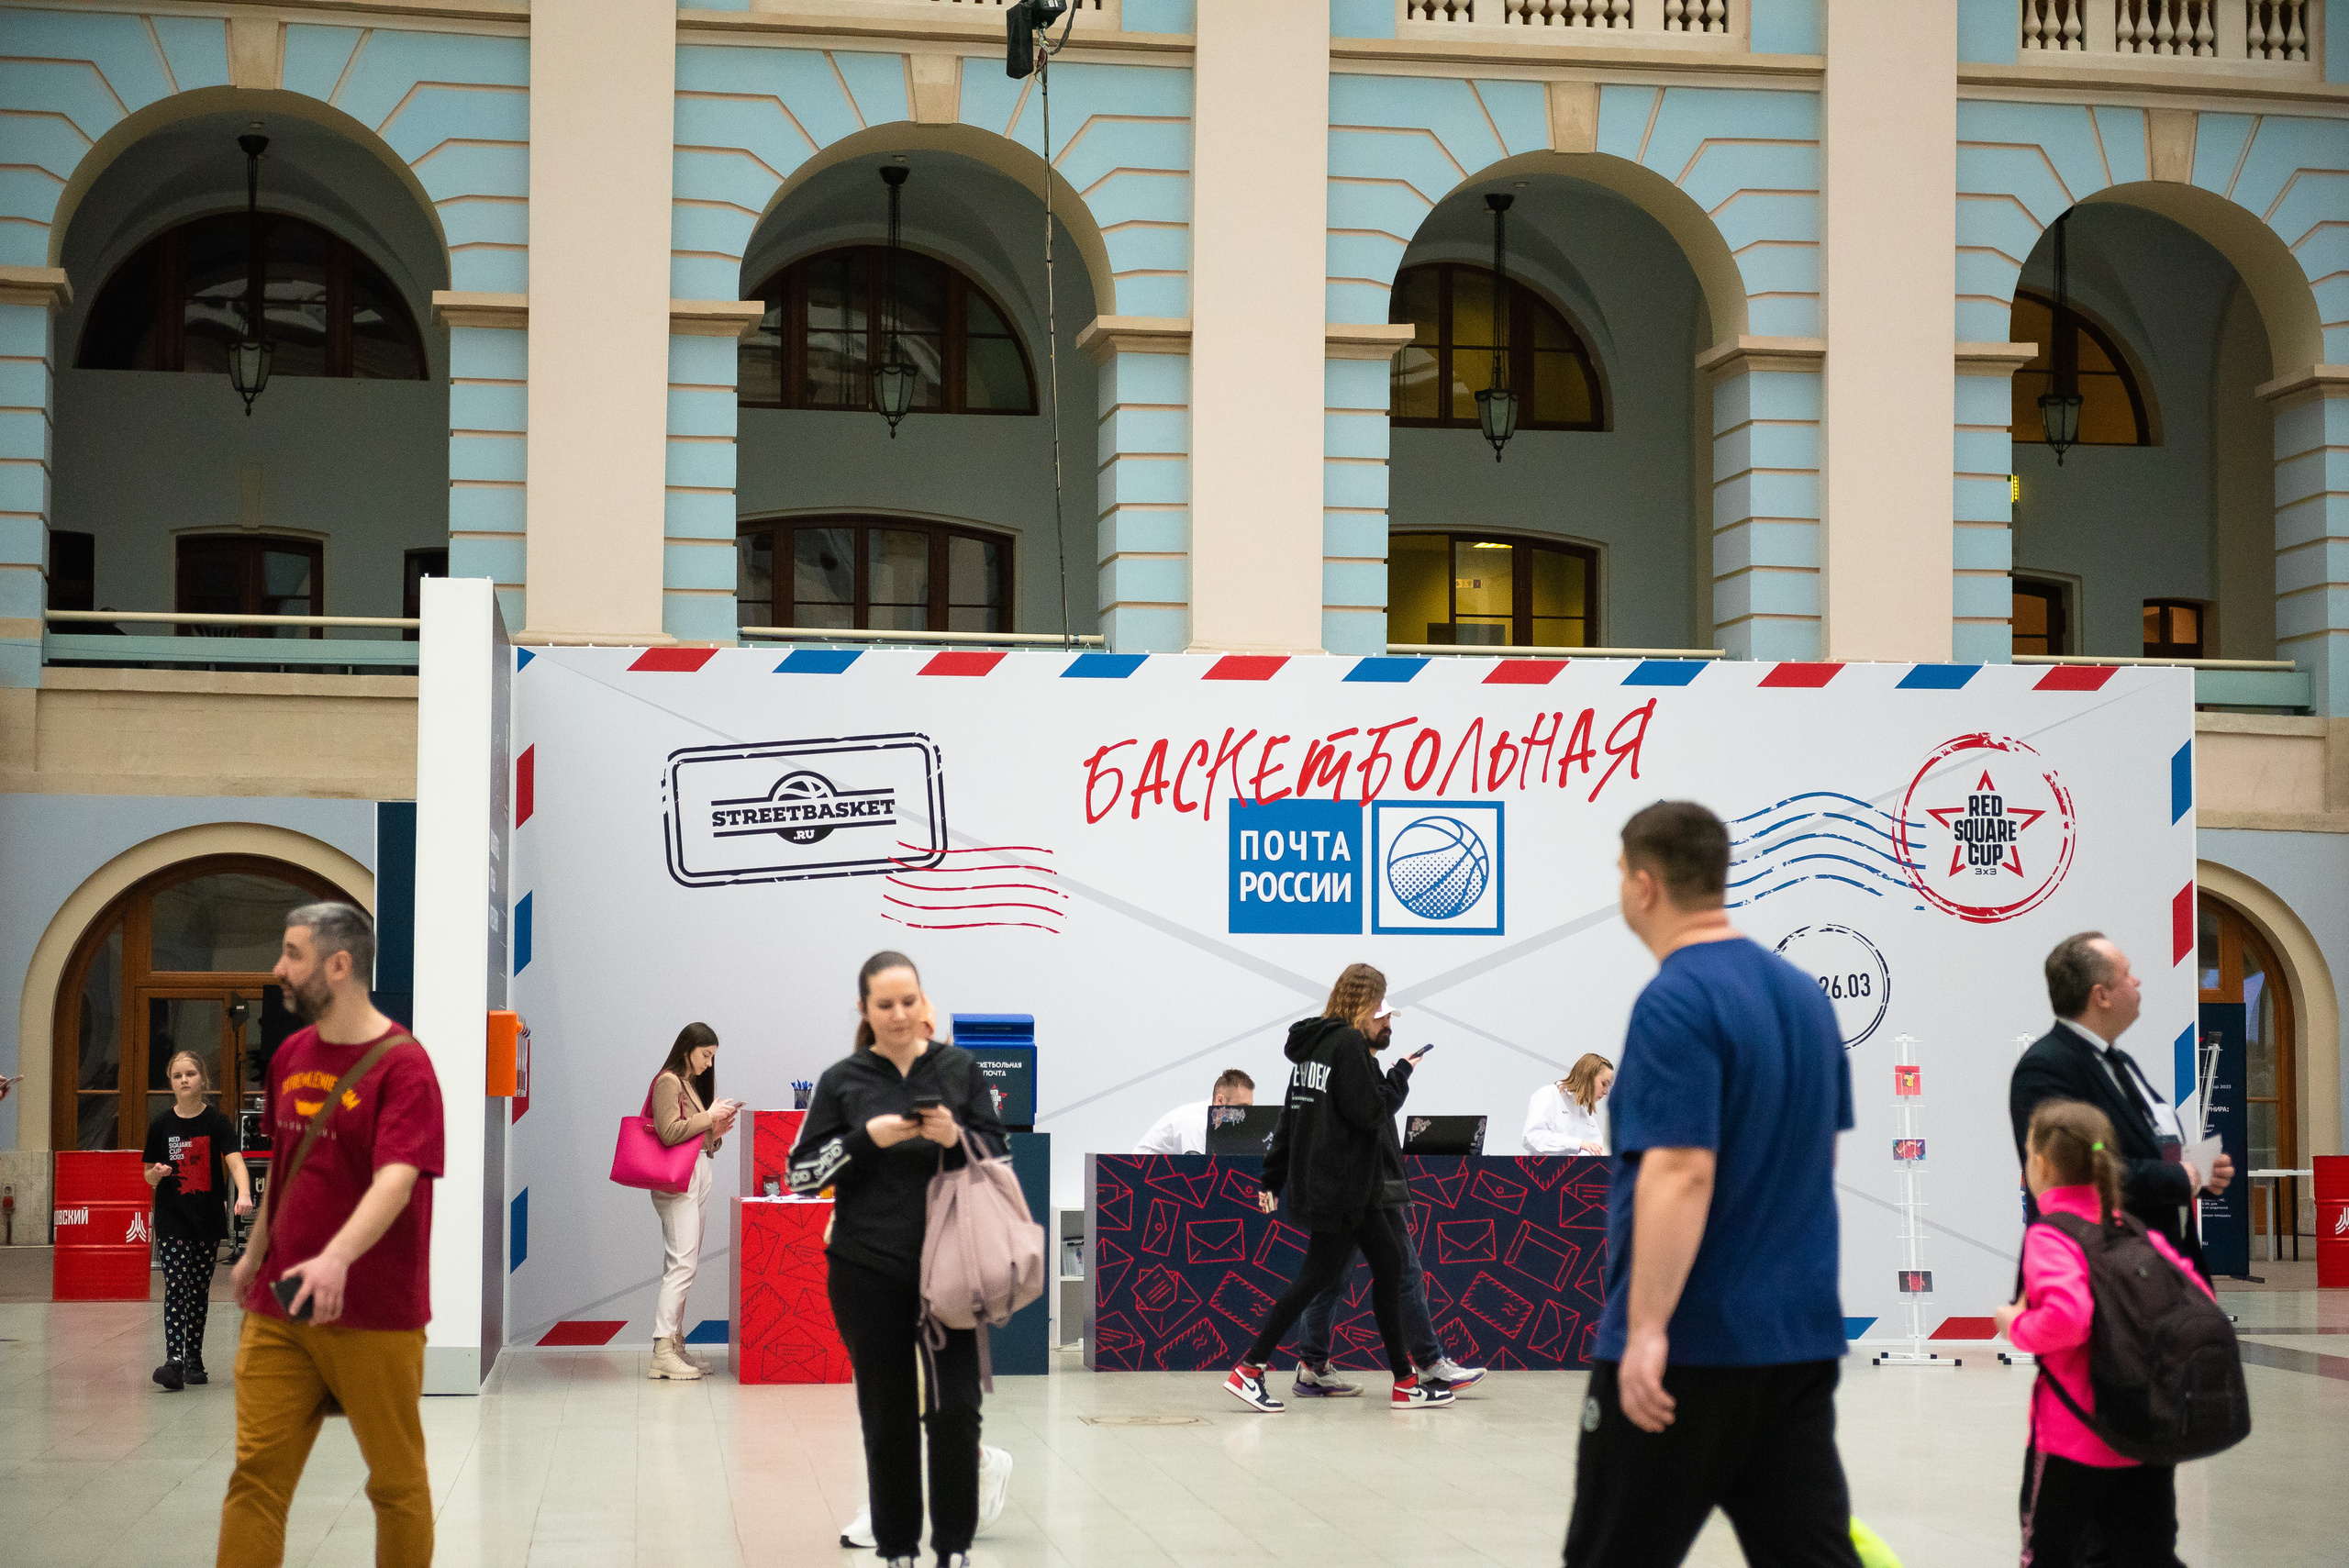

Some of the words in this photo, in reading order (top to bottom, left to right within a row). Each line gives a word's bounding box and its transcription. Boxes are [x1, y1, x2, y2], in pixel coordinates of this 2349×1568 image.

[712, 798, 896, 828] STREETBASKET
[1968, 795, 2003, 817] RED
[793, 829, 815, 840] .RU
[1954, 817, 2017, 844] SQUARE
[1240, 829, 1352, 862] ПОЧТА
[1967, 842, 2004, 866] CUP
[1240, 872, 1353, 904] РОССИИ
